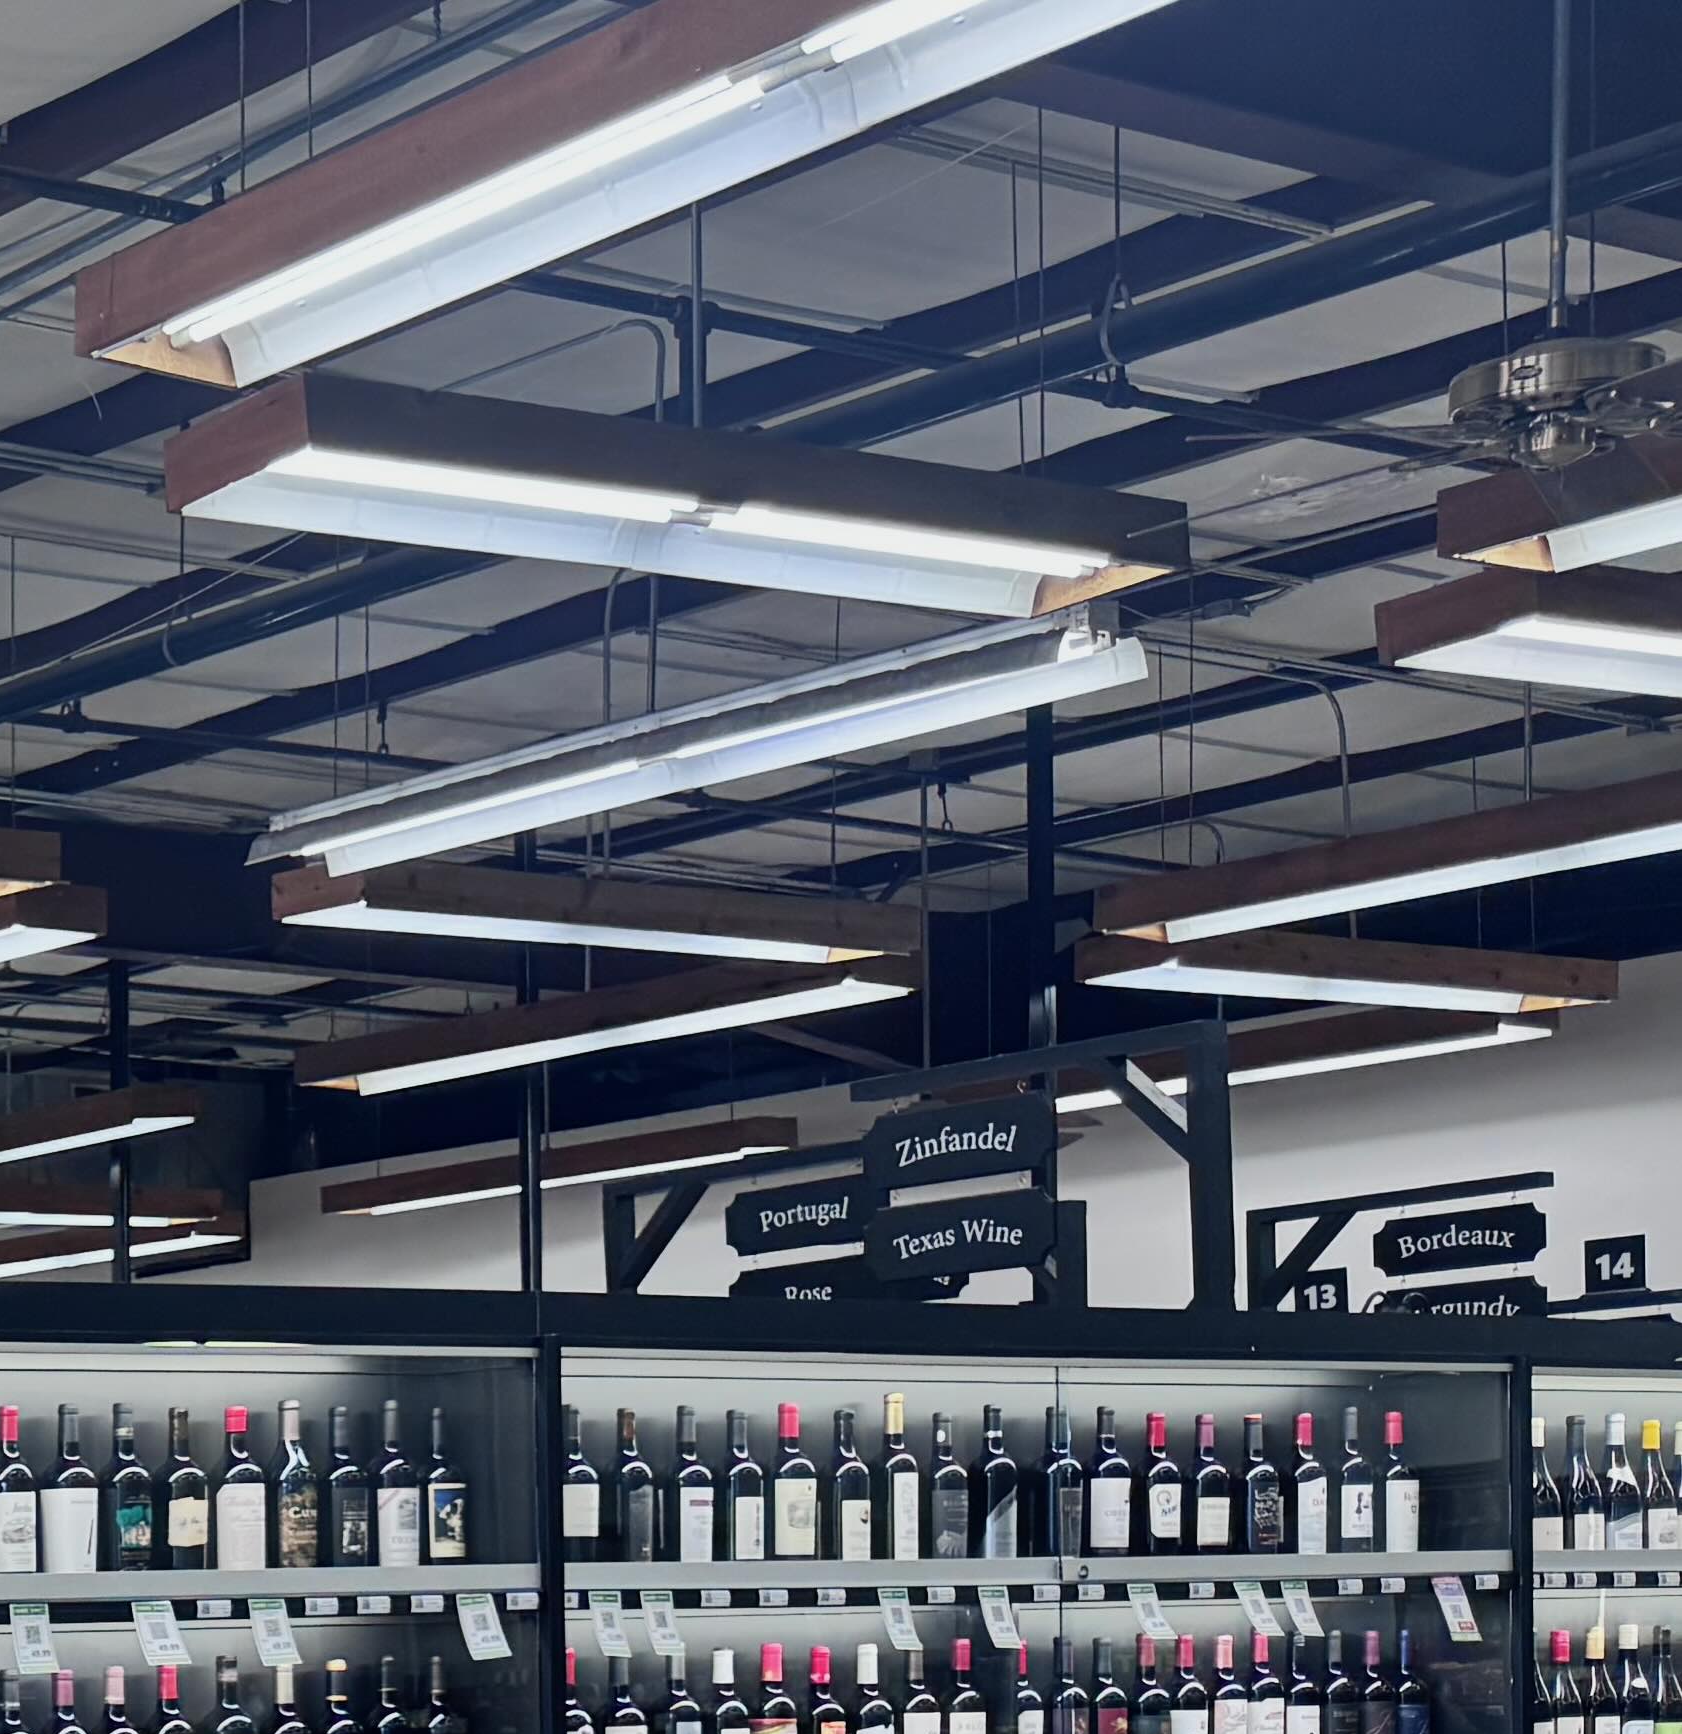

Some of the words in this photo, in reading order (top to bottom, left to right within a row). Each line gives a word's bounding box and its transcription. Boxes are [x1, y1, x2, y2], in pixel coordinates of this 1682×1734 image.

[895, 1122, 1017, 1167] Zinfandel
[759, 1196, 849, 1232] Portugal
[892, 1225, 956, 1260] Texas
[961, 1219, 1023, 1246] Wine
[1397, 1224, 1516, 1259] Bordeaux
[1595, 1252, 1635, 1281] 14
[1303, 1283, 1337, 1310] 13
